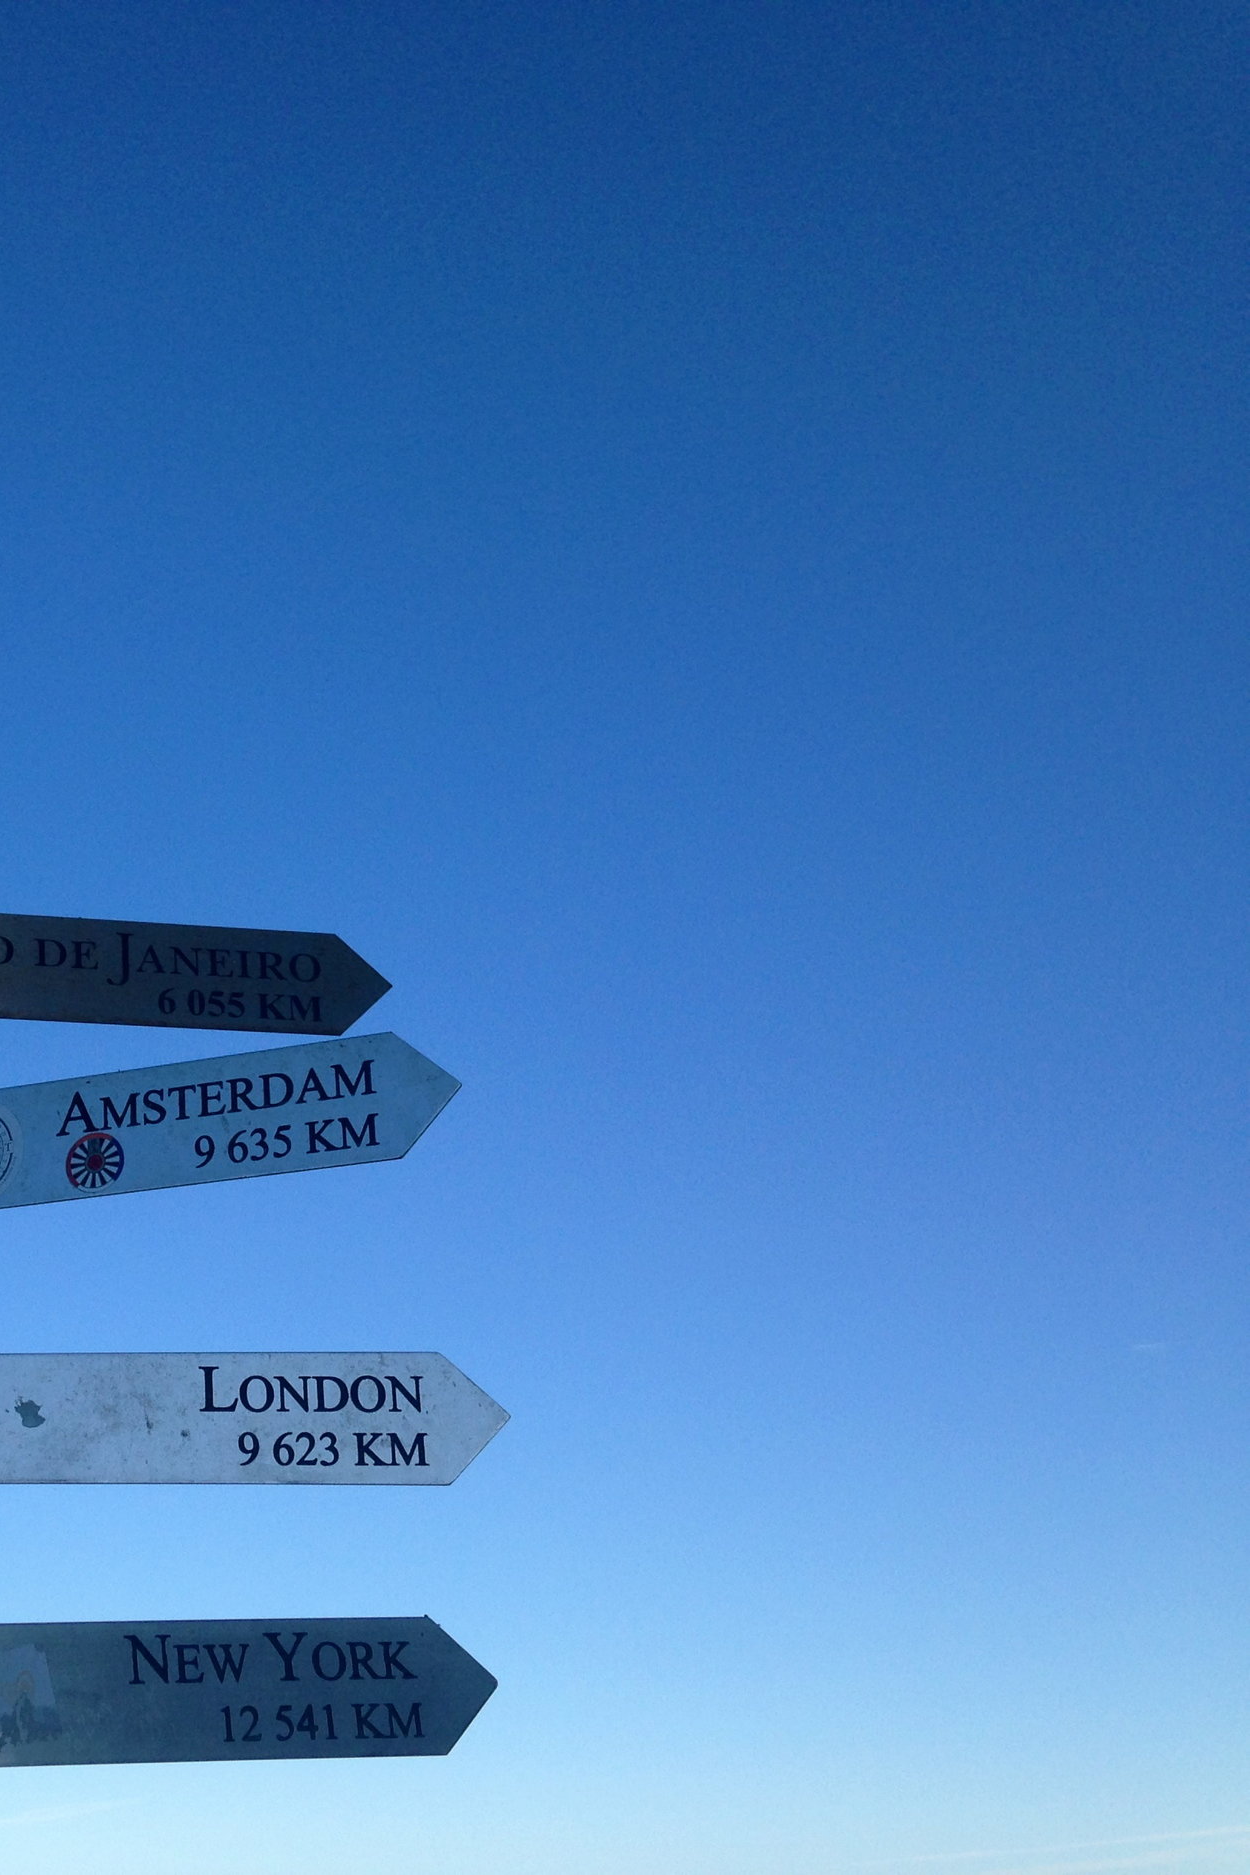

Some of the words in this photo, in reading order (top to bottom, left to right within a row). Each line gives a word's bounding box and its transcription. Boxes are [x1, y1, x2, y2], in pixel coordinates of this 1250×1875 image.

[33, 937, 100, 971] DE
[106, 931, 323, 987] JANEIRO
[158, 987, 178, 1016] 6
[186, 987, 246, 1019] 055
[256, 992, 324, 1023] KM
[55, 1059, 378, 1137] AMSTERDAM
[194, 1134, 216, 1169] 9
[226, 1123, 292, 1164] 635
[305, 1112, 380, 1155] KM
[197, 1365, 425, 1414] LONDON
[237, 1431, 261, 1467] 9
[272, 1431, 340, 1467] 623
[351, 1431, 431, 1467] KM
[122, 1633, 251, 1686] NEW
[261, 1631, 419, 1683] YORK
[219, 1704, 261, 1743] 12
[275, 1703, 339, 1742] 541
[350, 1701, 426, 1740] KM
